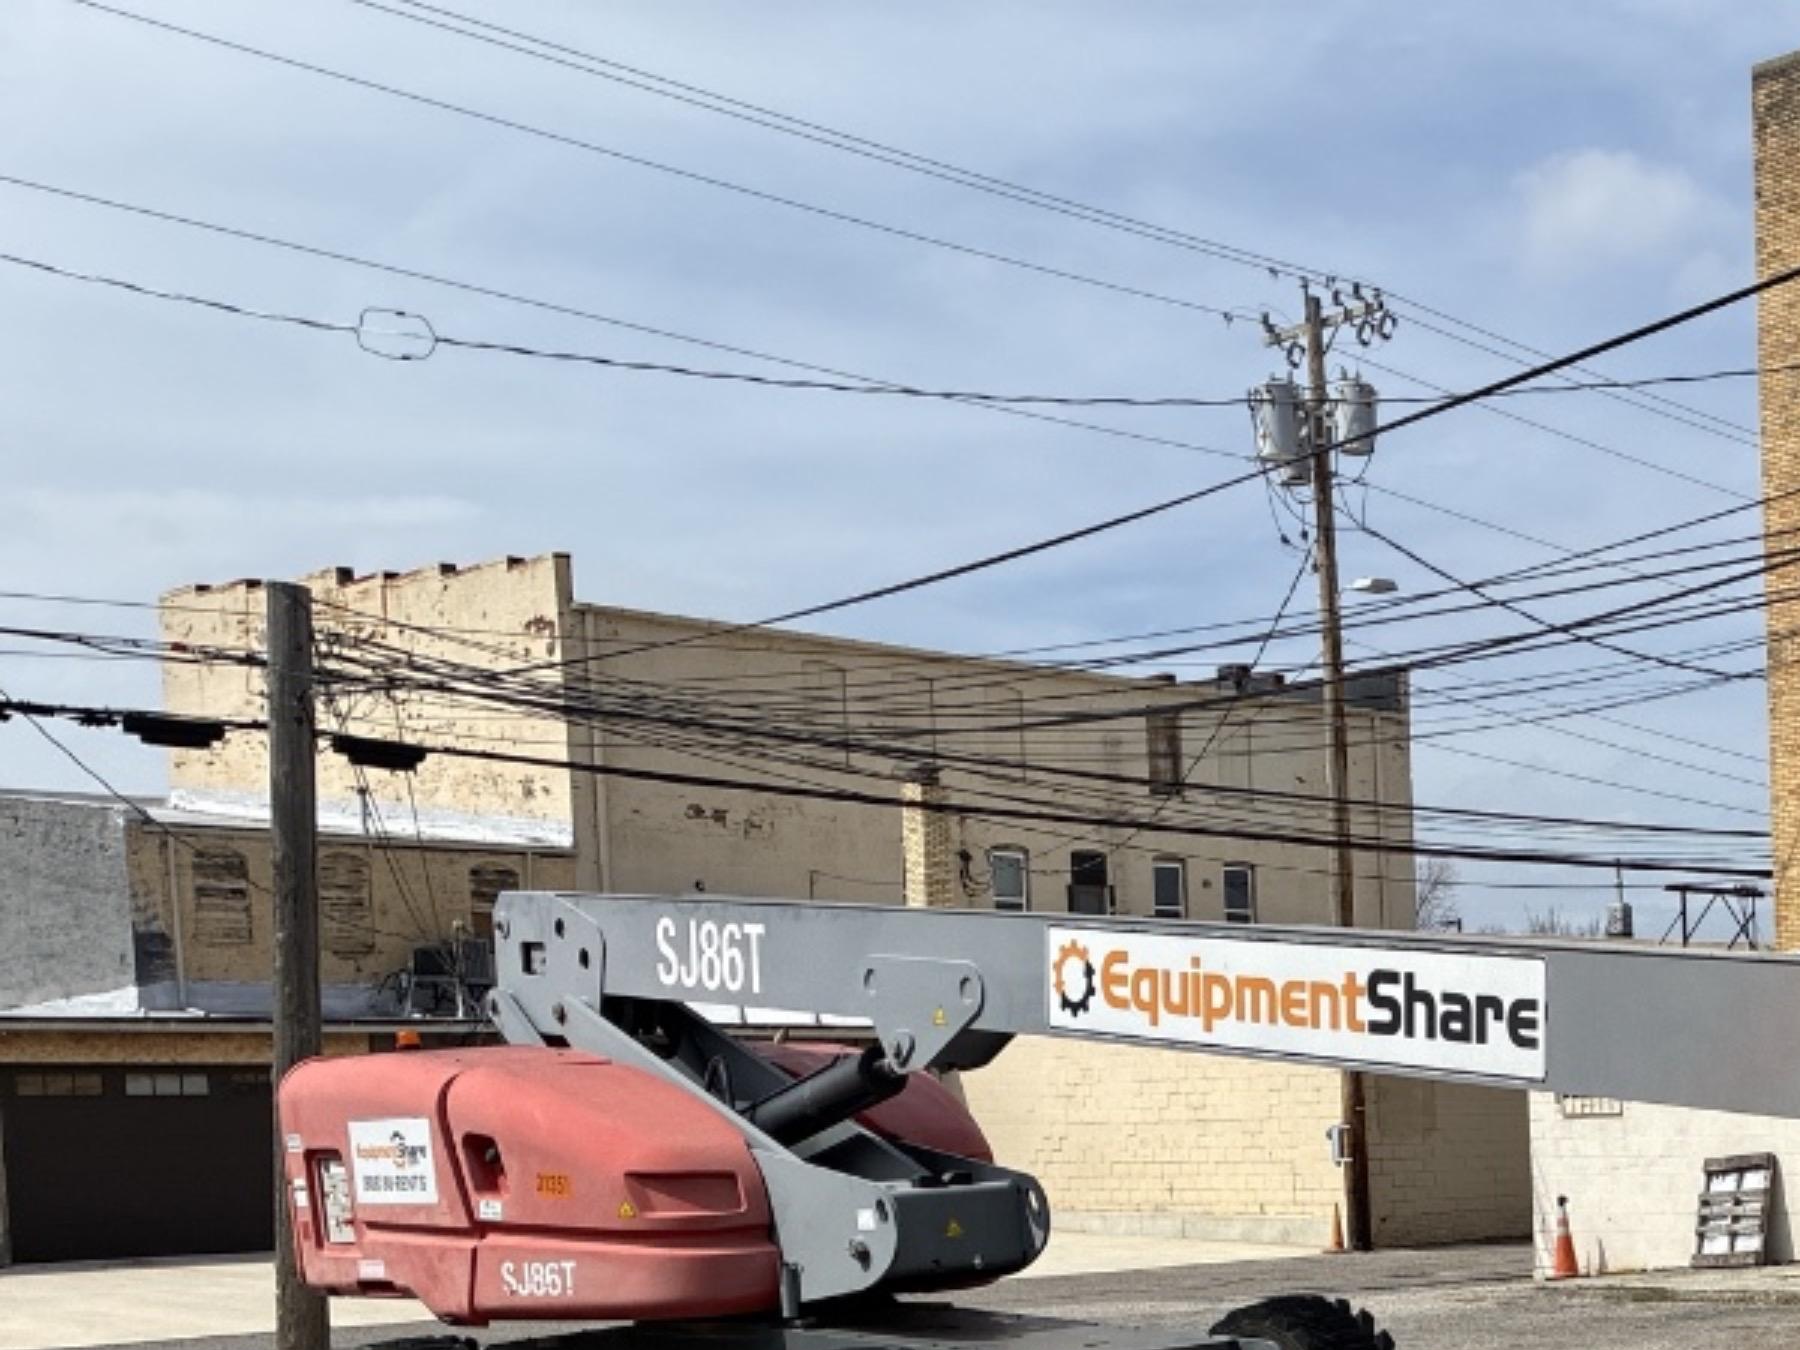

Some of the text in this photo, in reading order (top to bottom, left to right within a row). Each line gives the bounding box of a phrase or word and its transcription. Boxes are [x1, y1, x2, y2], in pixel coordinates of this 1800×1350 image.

[656, 916, 766, 994] SJ86T
[1101, 950, 1540, 1051] EquipmentShare
[501, 1261, 577, 1297] SJ86T
